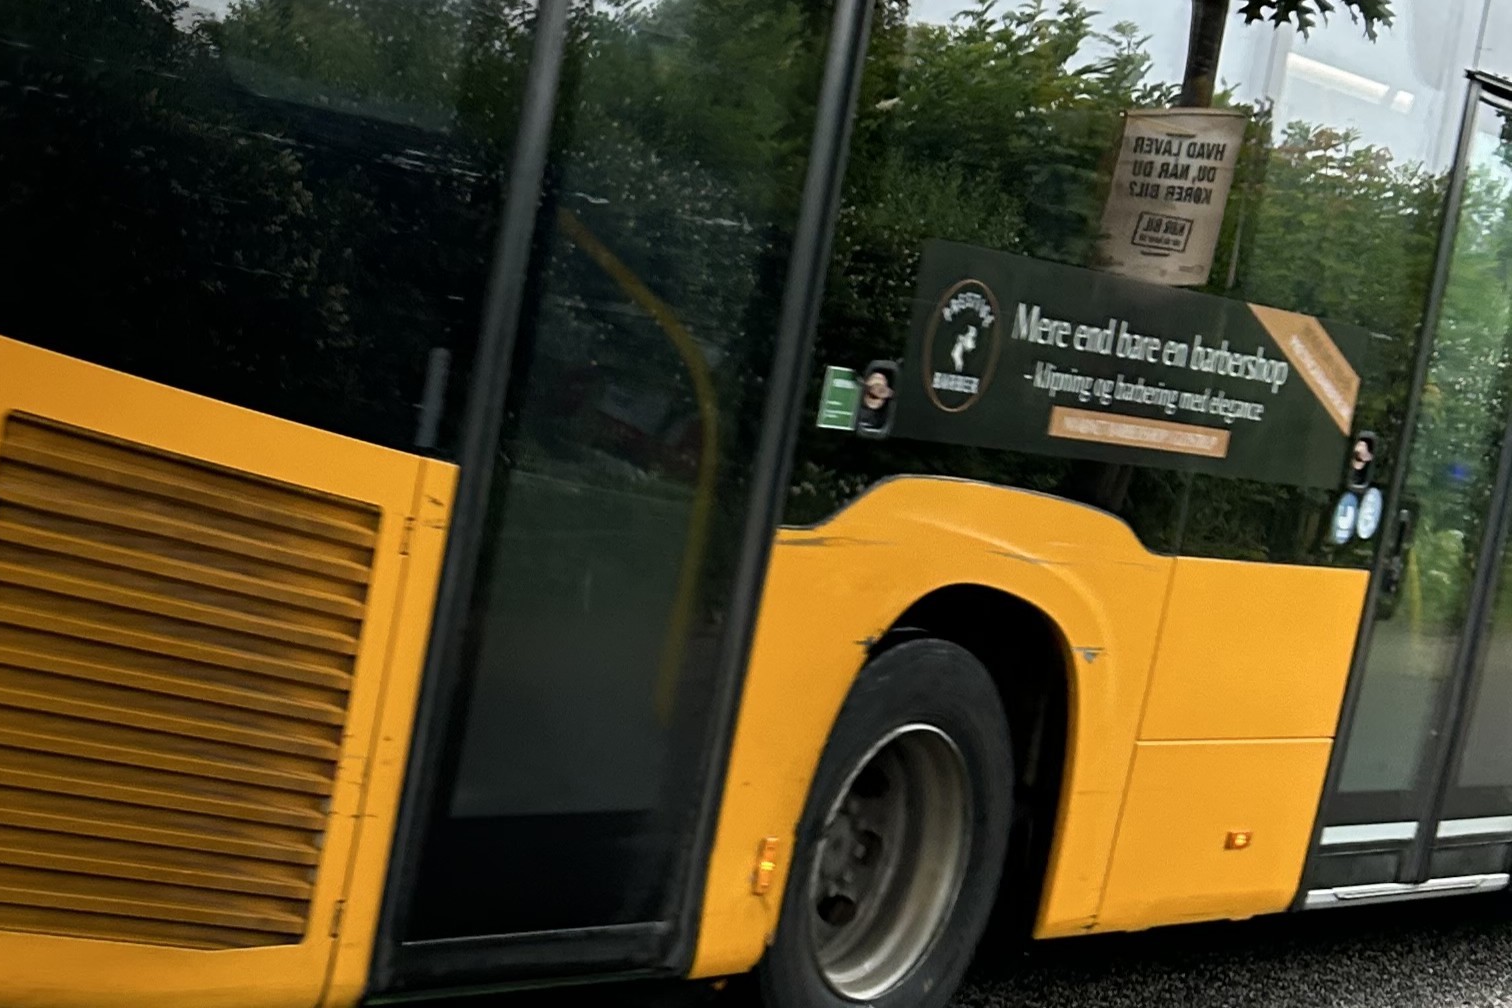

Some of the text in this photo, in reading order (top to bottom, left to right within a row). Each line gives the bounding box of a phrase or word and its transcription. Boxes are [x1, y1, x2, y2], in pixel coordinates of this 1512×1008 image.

[1011, 302, 1073, 348] Mere
[1073, 318, 1118, 356] end
[1116, 320, 1162, 363] bare
[1161, 340, 1190, 368] en
[1189, 334, 1289, 394] barbershop
[1093, 377, 1115, 406] og
[1114, 373, 1179, 415] barbering
[1178, 388, 1211, 413] med
[1207, 390, 1265, 424] elegance
